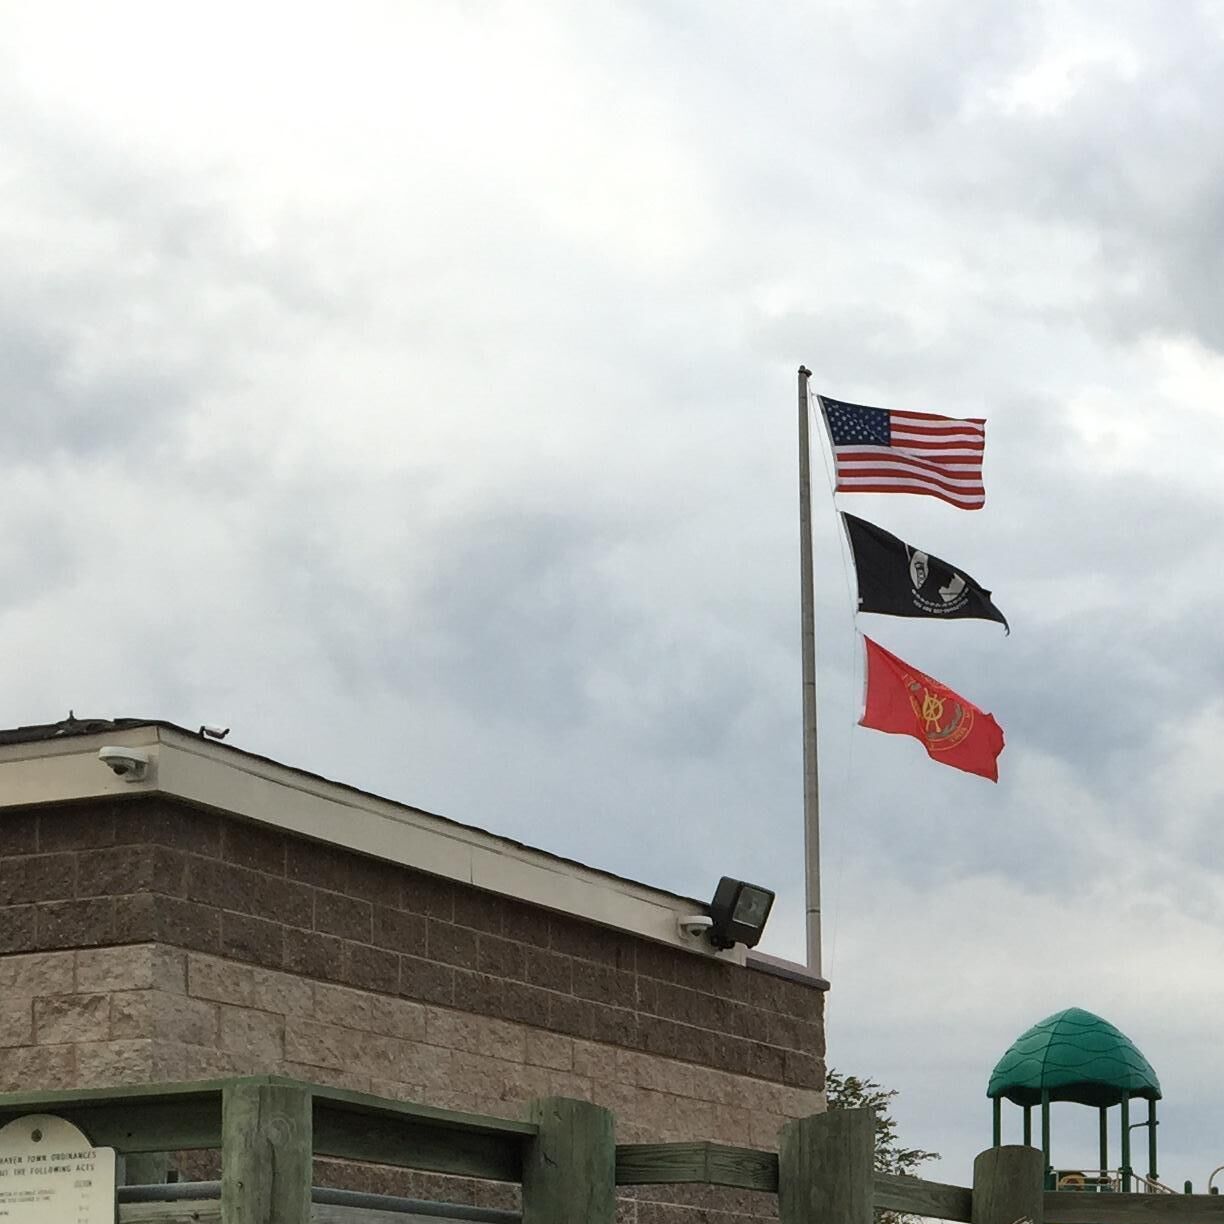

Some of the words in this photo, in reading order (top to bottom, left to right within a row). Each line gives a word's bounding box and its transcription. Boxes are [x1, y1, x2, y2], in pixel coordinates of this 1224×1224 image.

[27, 1154, 47, 1163] TOWN
[51, 1151, 96, 1161] ORDINANCES
[30, 1165, 71, 1175] FOLLOWING
[76, 1163, 95, 1172] ACTS
